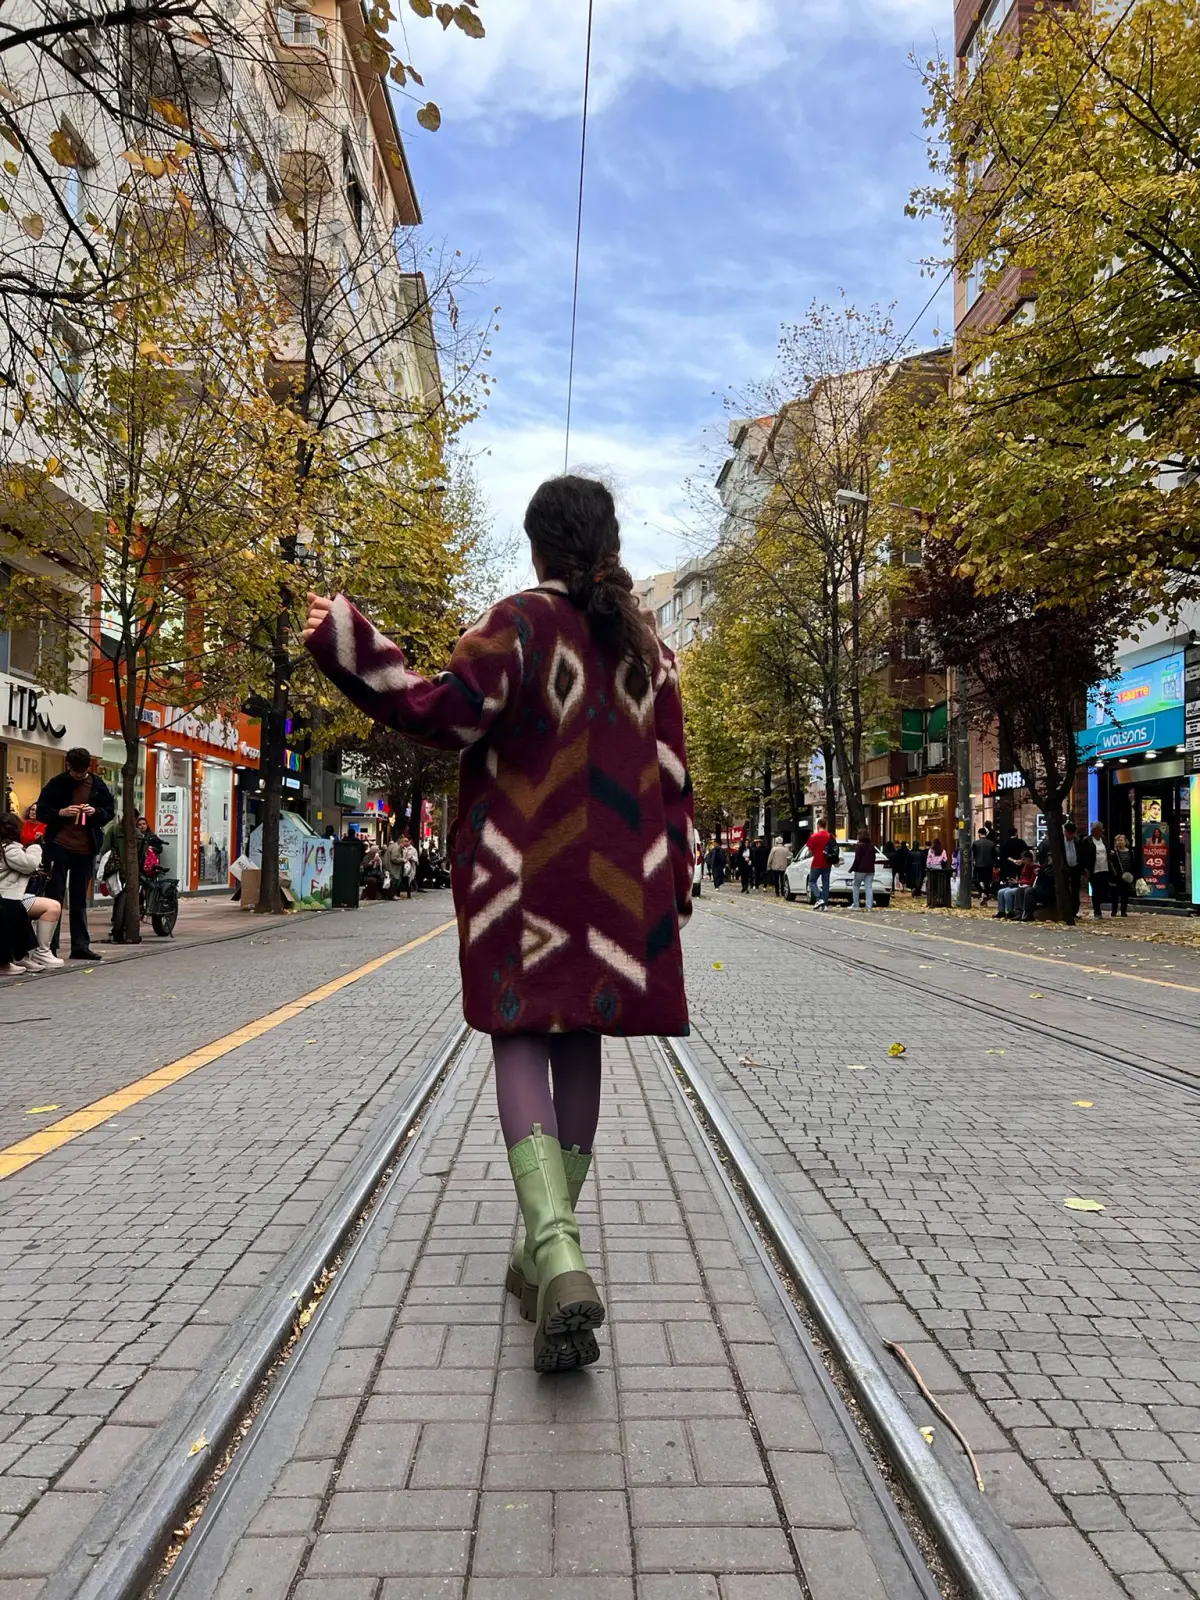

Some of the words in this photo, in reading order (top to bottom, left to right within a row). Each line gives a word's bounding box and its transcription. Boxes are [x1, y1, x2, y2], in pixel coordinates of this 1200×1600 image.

[8, 682, 38, 732] LTB
[1103, 727, 1147, 748] watsons
[17, 756, 38, 774] LTB
[983, 770, 997, 796] IN
